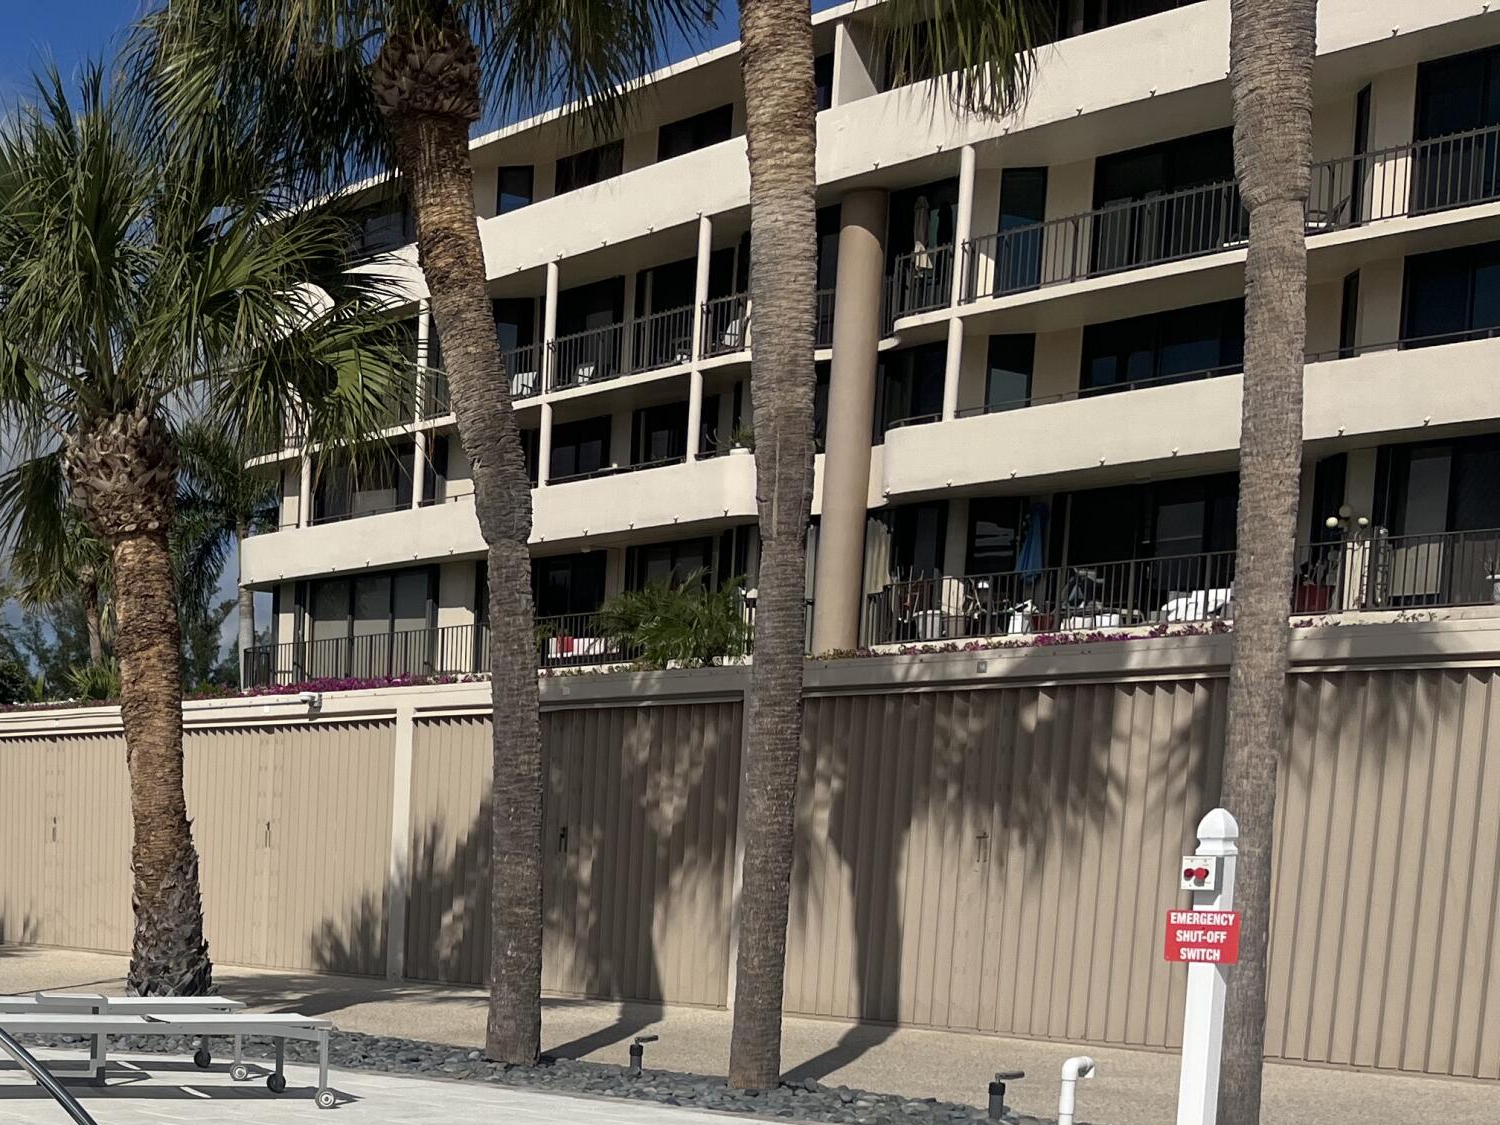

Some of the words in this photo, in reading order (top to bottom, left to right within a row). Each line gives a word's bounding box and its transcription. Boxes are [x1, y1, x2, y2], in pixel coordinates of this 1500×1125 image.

[1170, 912, 1235, 926] EMERGENCY
[1175, 930, 1227, 943] SHUT-OFF
[1180, 947, 1220, 961] SWITCH
